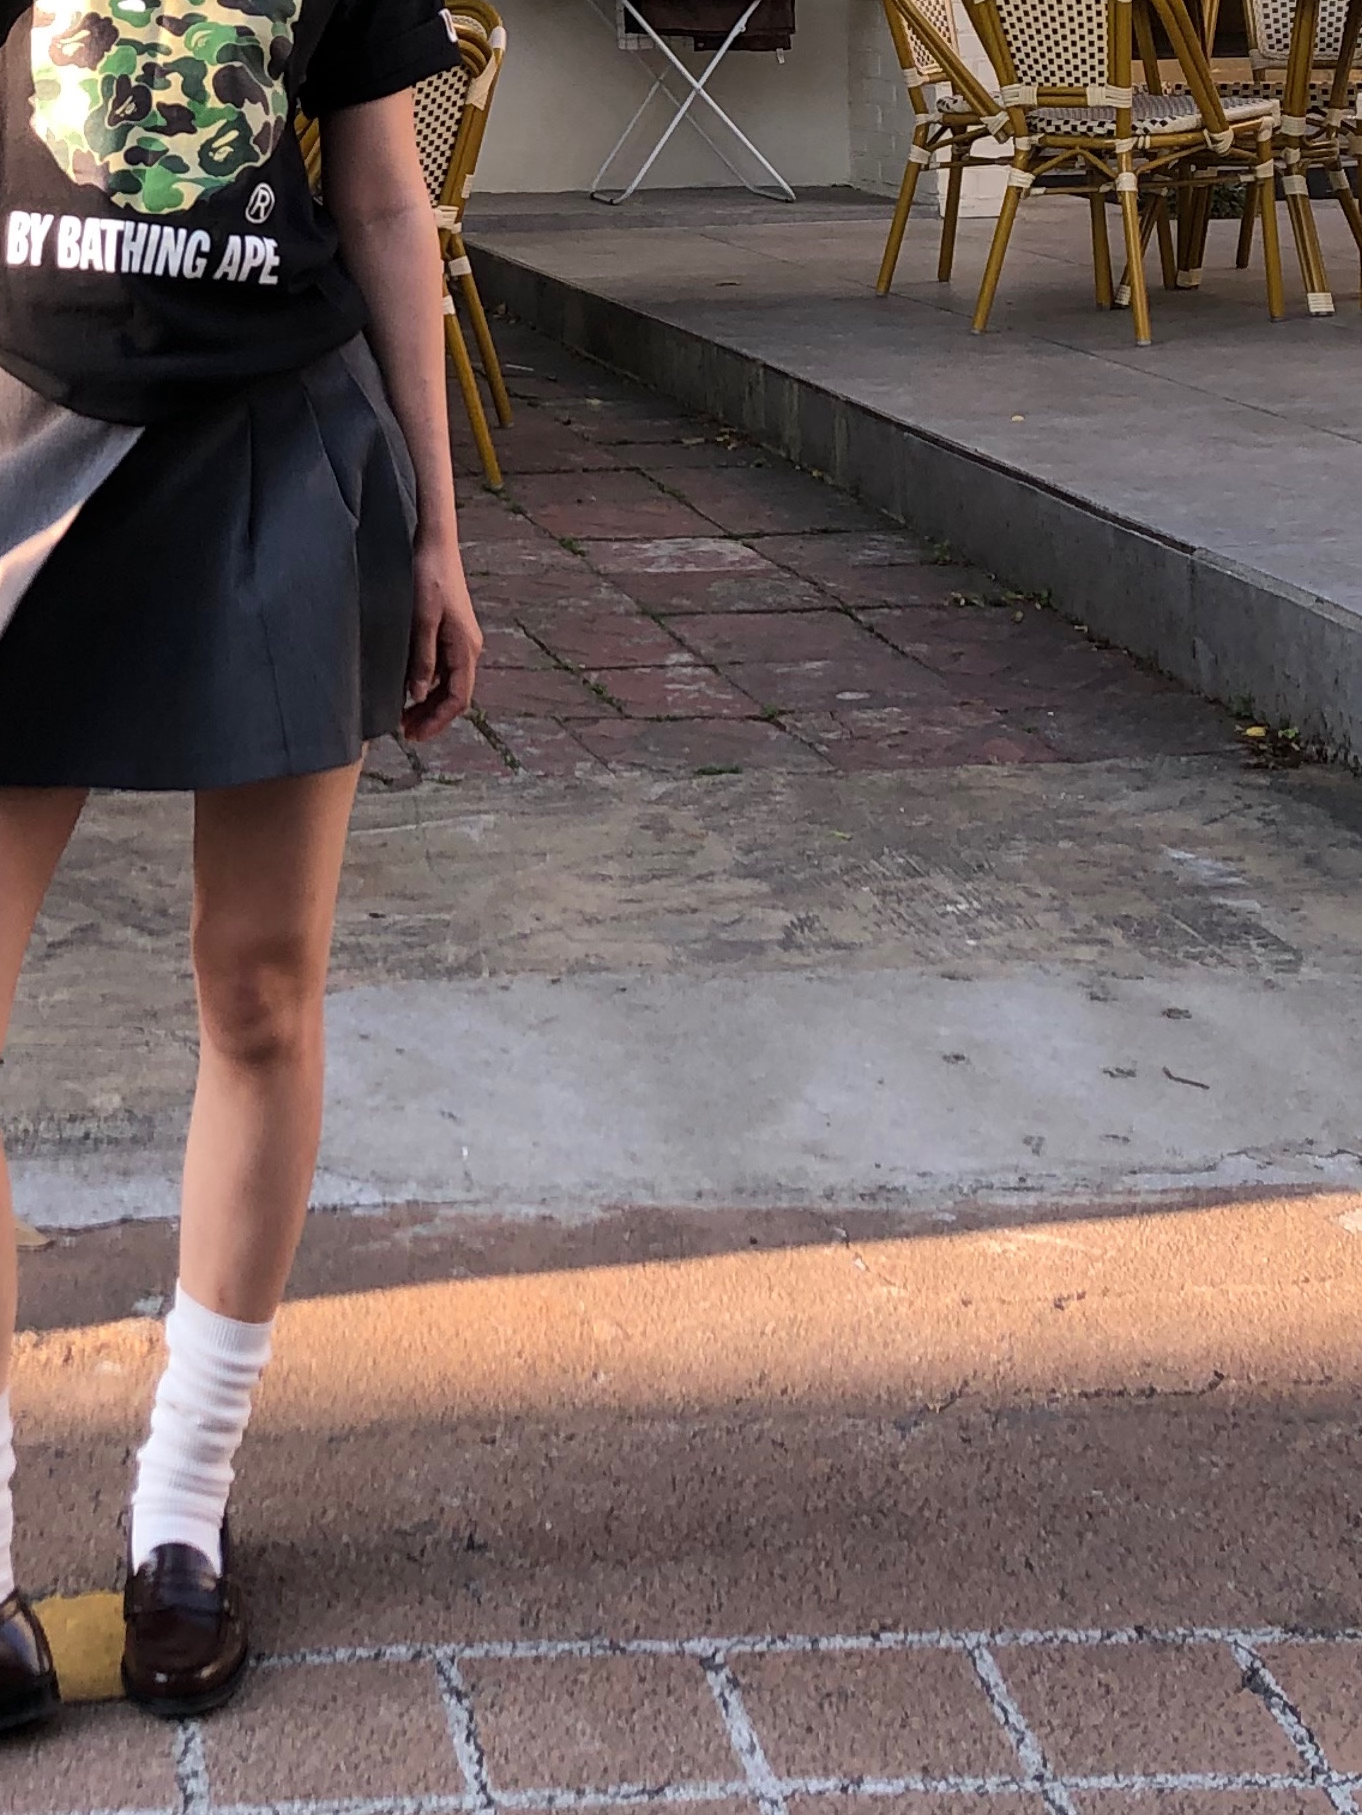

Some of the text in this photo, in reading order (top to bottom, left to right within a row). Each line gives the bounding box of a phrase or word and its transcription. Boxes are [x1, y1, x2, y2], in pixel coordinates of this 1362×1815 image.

[5, 210, 280, 285] BY BATHING APE
